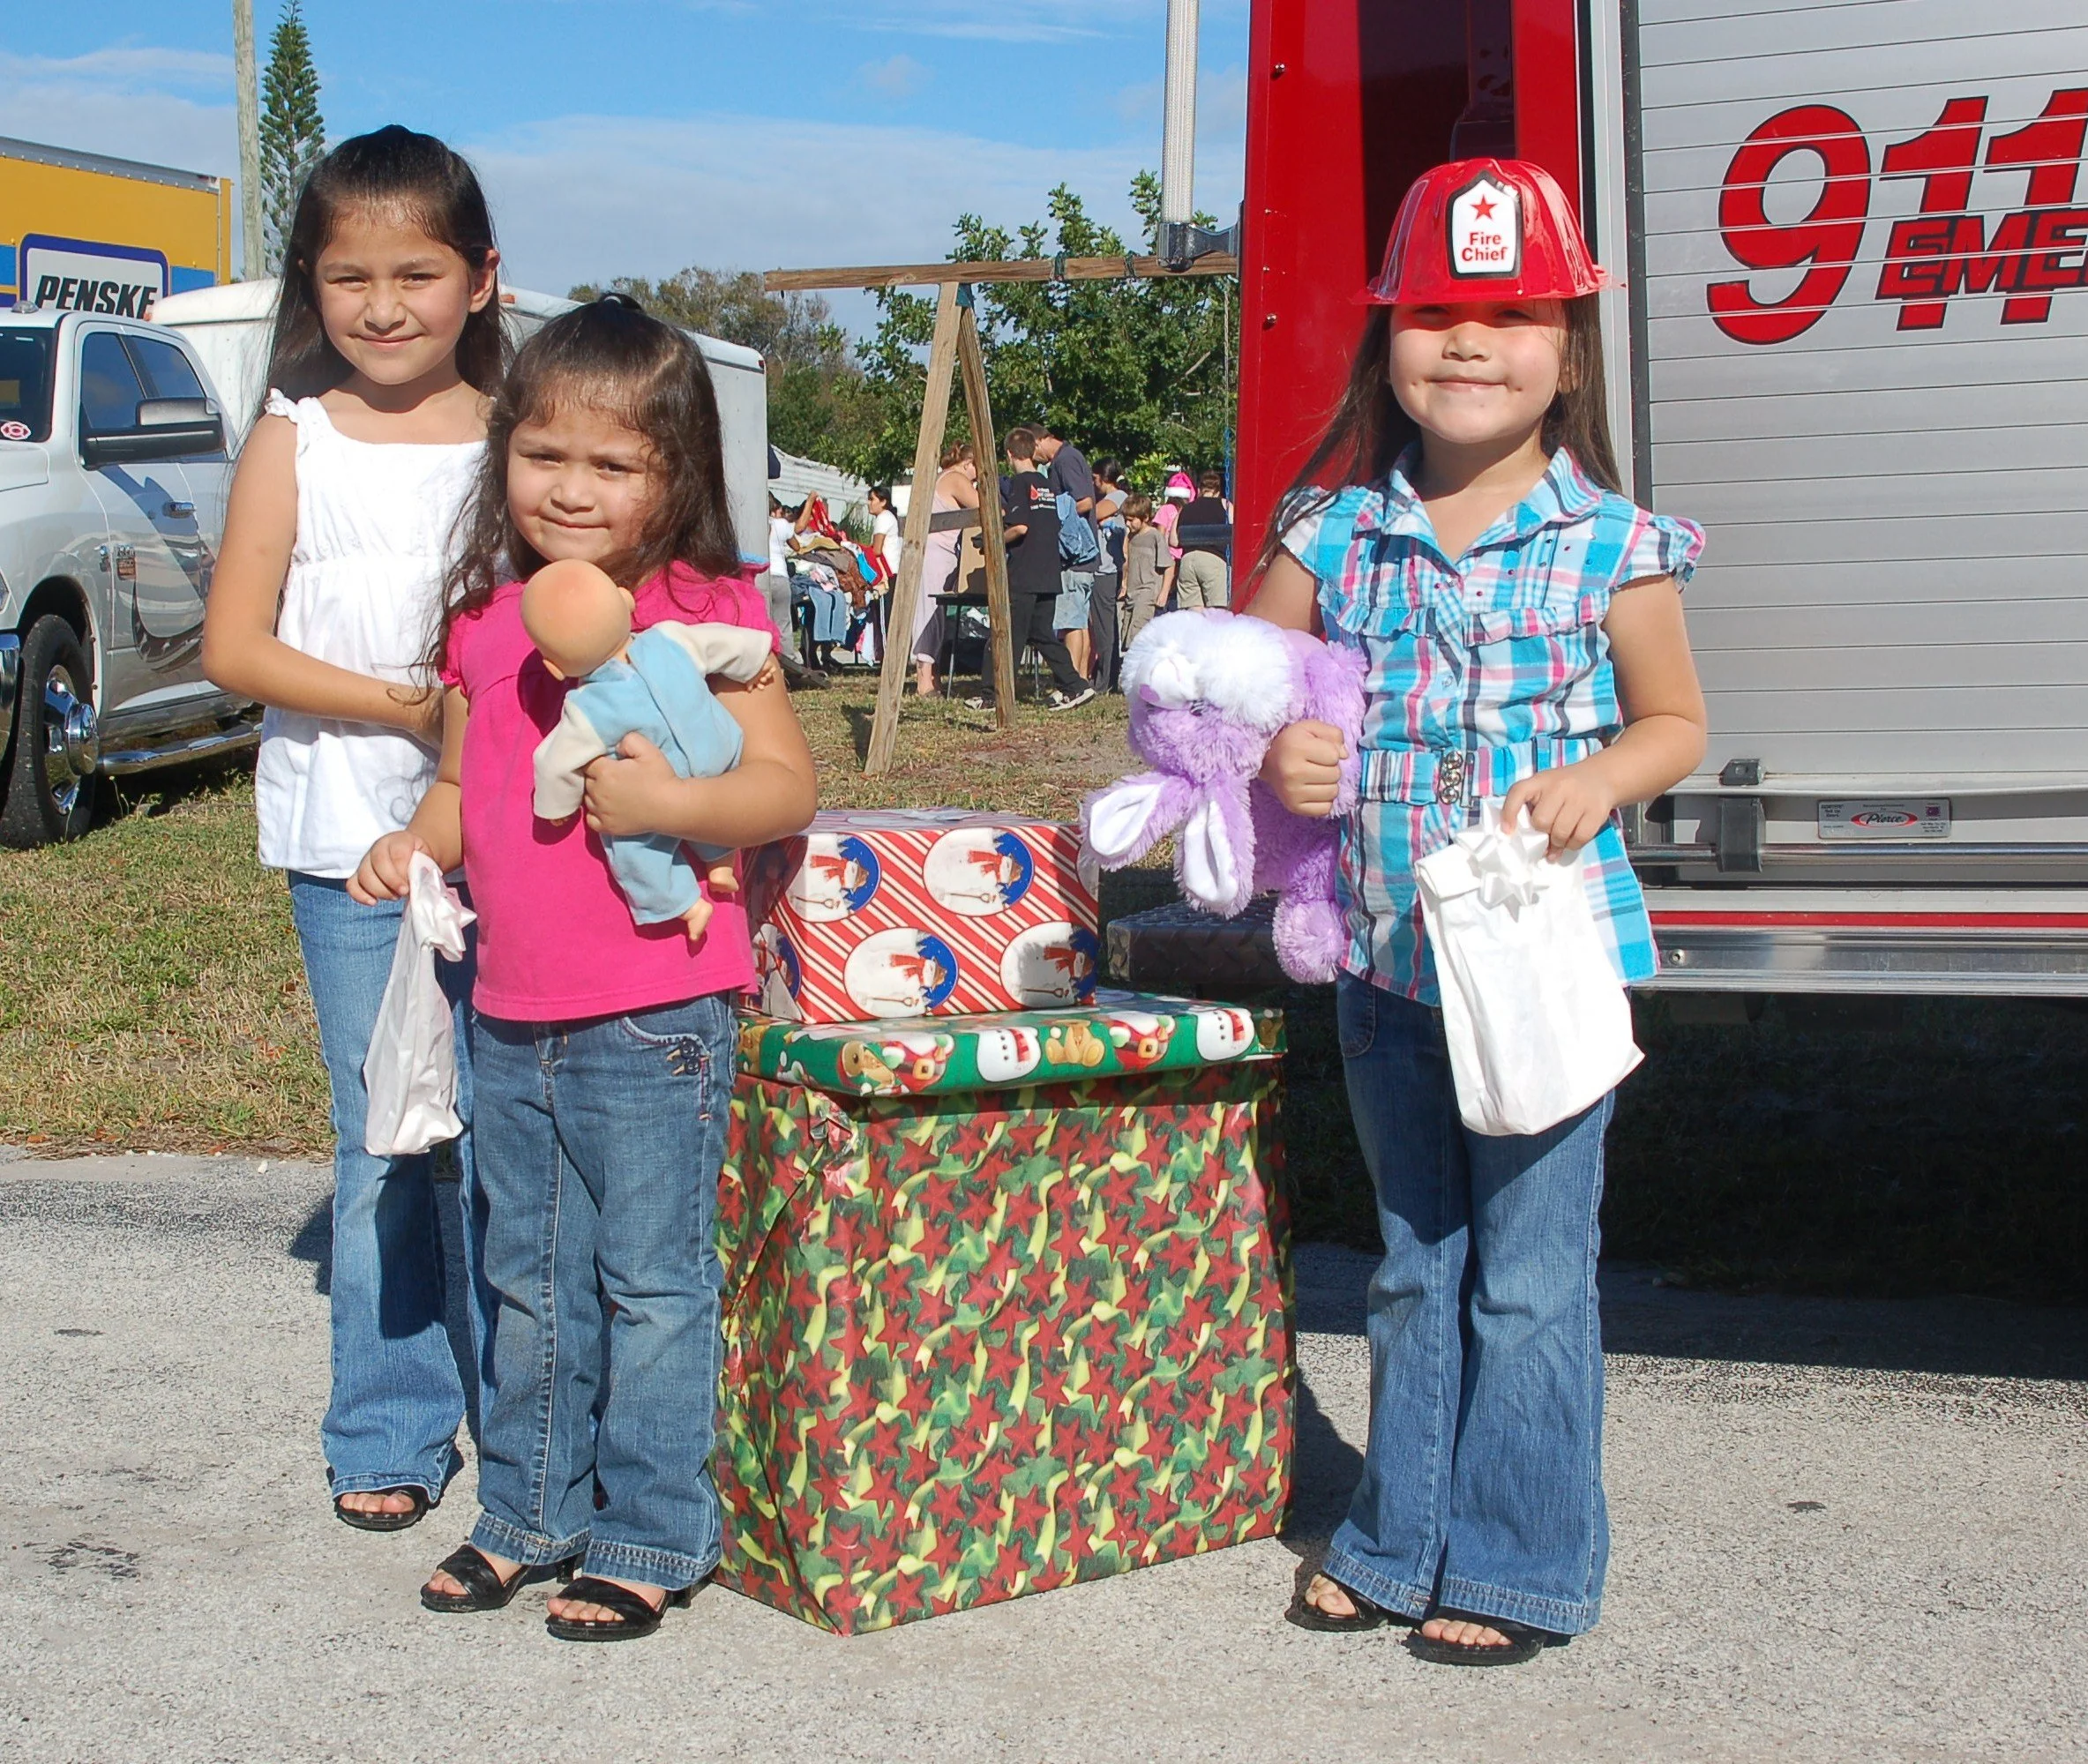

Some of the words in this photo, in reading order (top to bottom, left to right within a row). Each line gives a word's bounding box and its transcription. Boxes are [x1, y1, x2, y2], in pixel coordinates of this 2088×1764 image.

[1706, 87, 2088, 346] 911
[1469, 231, 1502, 245] Fire
[1461, 247, 1508, 262] Chief
[1875, 207, 2088, 300] EME
[34, 274, 158, 319] PENSKE
[1865, 812, 1902, 825] Pierce
